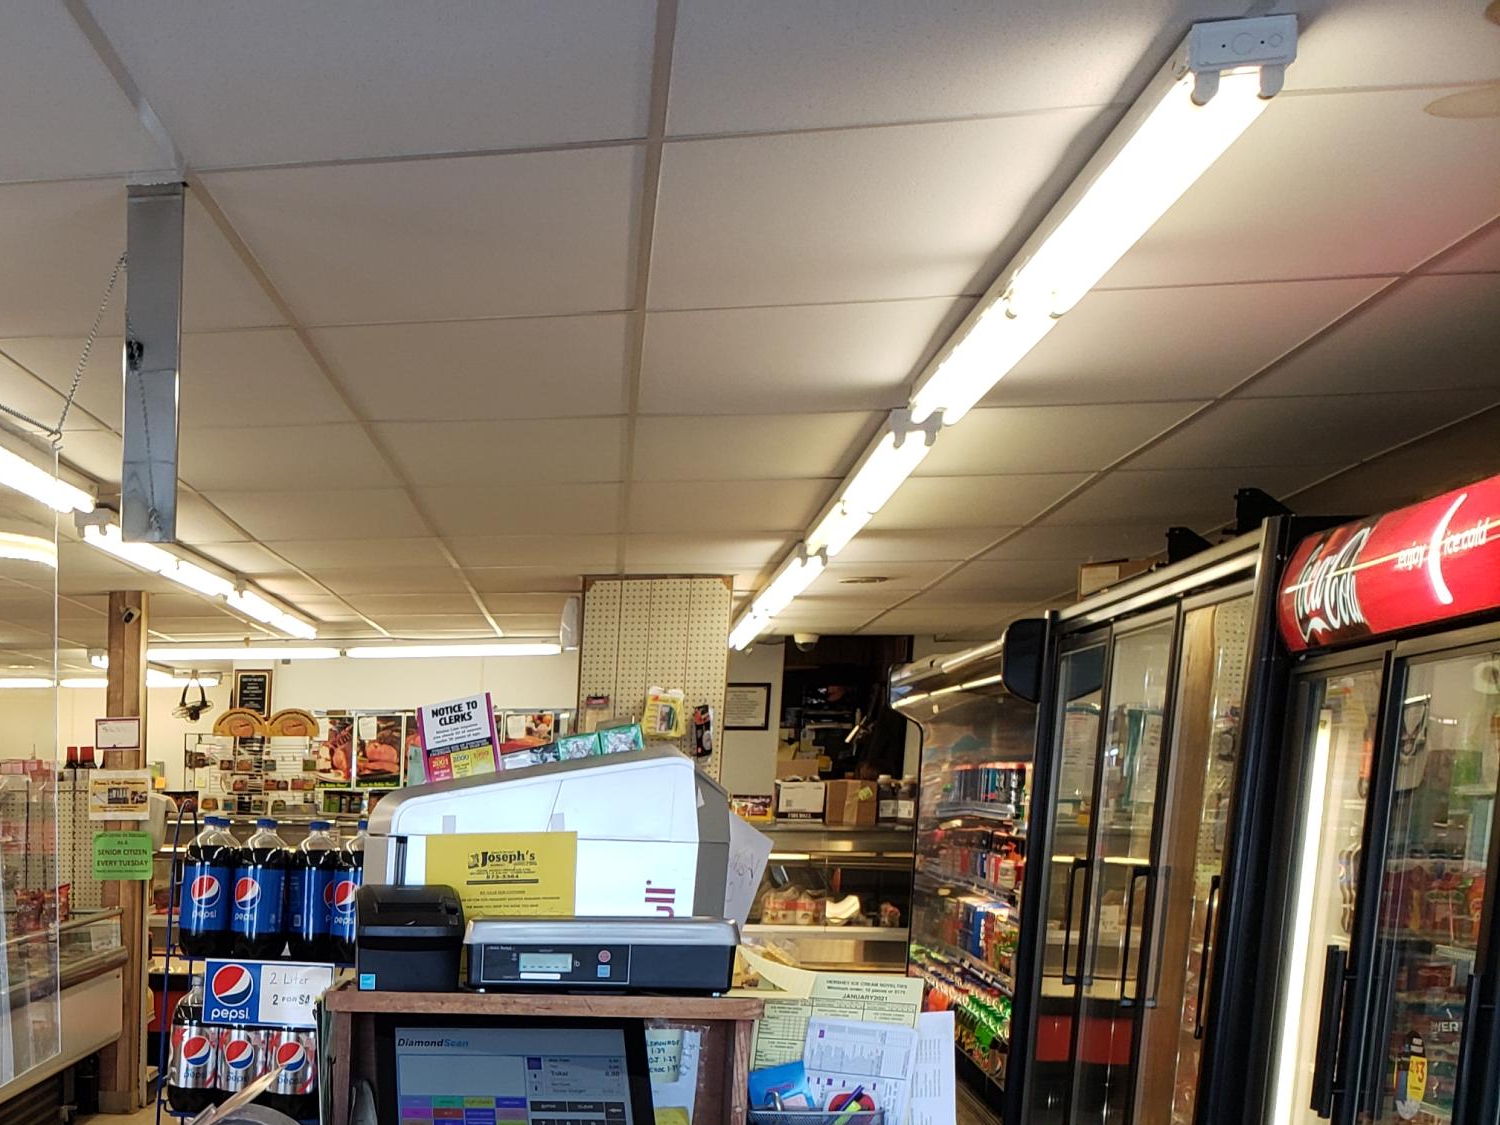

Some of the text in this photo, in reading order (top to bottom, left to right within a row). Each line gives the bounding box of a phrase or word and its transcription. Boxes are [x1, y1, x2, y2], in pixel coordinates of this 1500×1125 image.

[431, 700, 478, 718] NOTICE TO
[439, 711, 473, 727] CLERKS
[481, 850, 536, 867] Joseph's
[270, 972, 309, 985] 2 Liter
[272, 994, 279, 1006] 2
[211, 1007, 249, 1021] pepsi
[397, 1038, 469, 1048] DiamondScan
